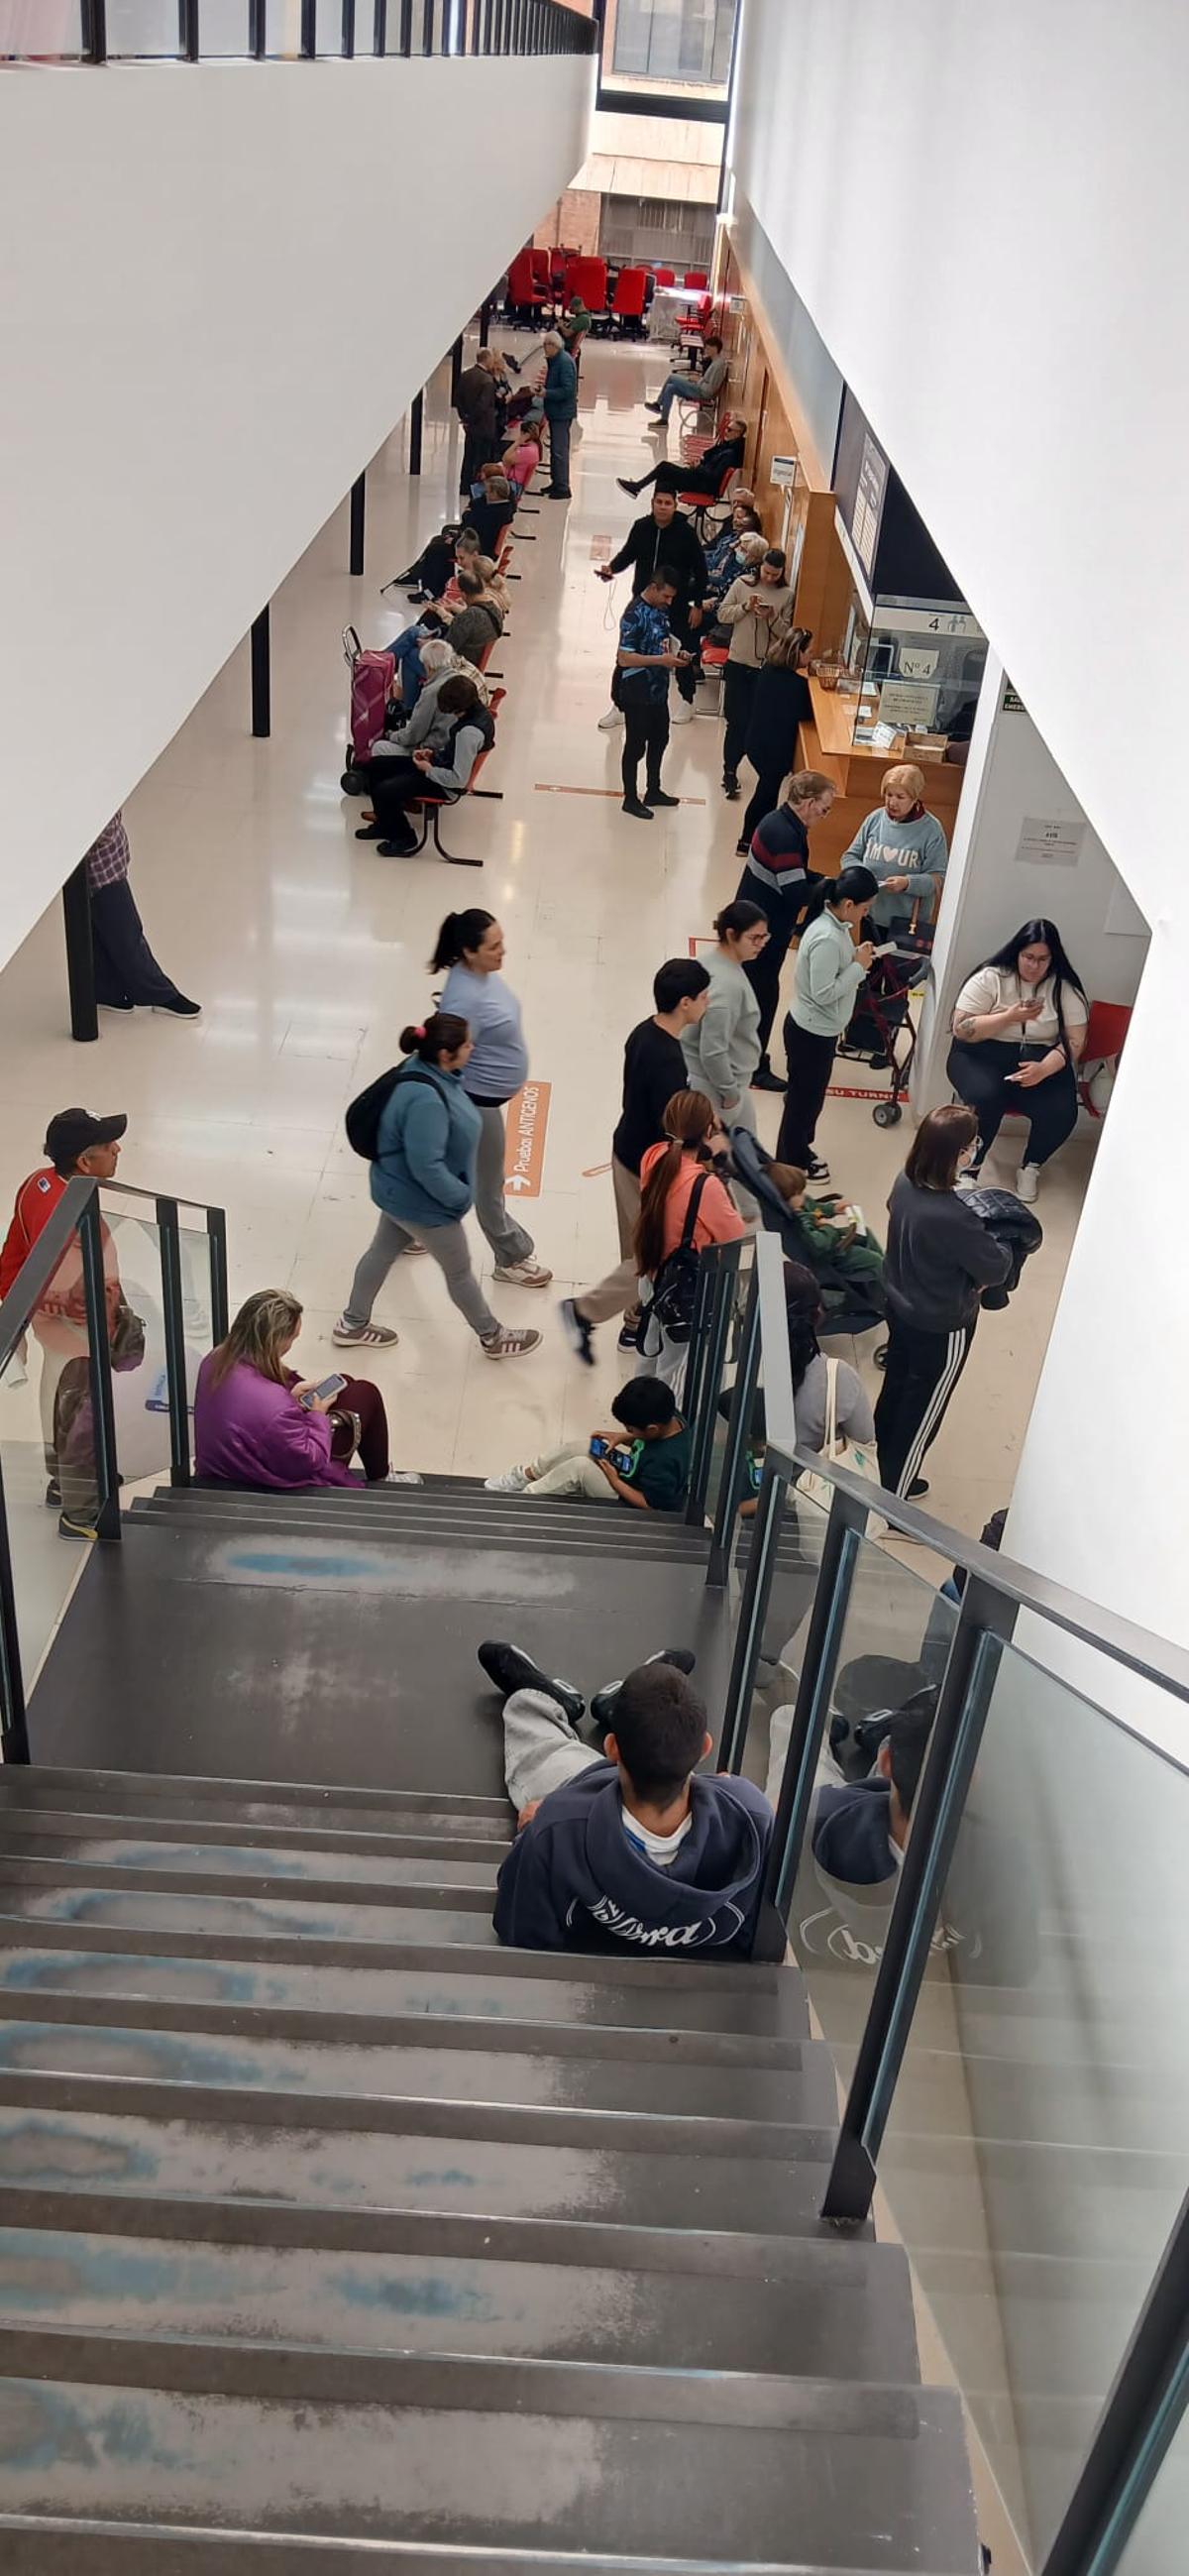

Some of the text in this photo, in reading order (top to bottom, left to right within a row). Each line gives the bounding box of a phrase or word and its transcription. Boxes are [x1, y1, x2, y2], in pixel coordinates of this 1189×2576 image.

[929, 617, 940, 630] 4
[922, 665, 930, 675] 4
[513, 1138, 533, 1173] Pruebas
